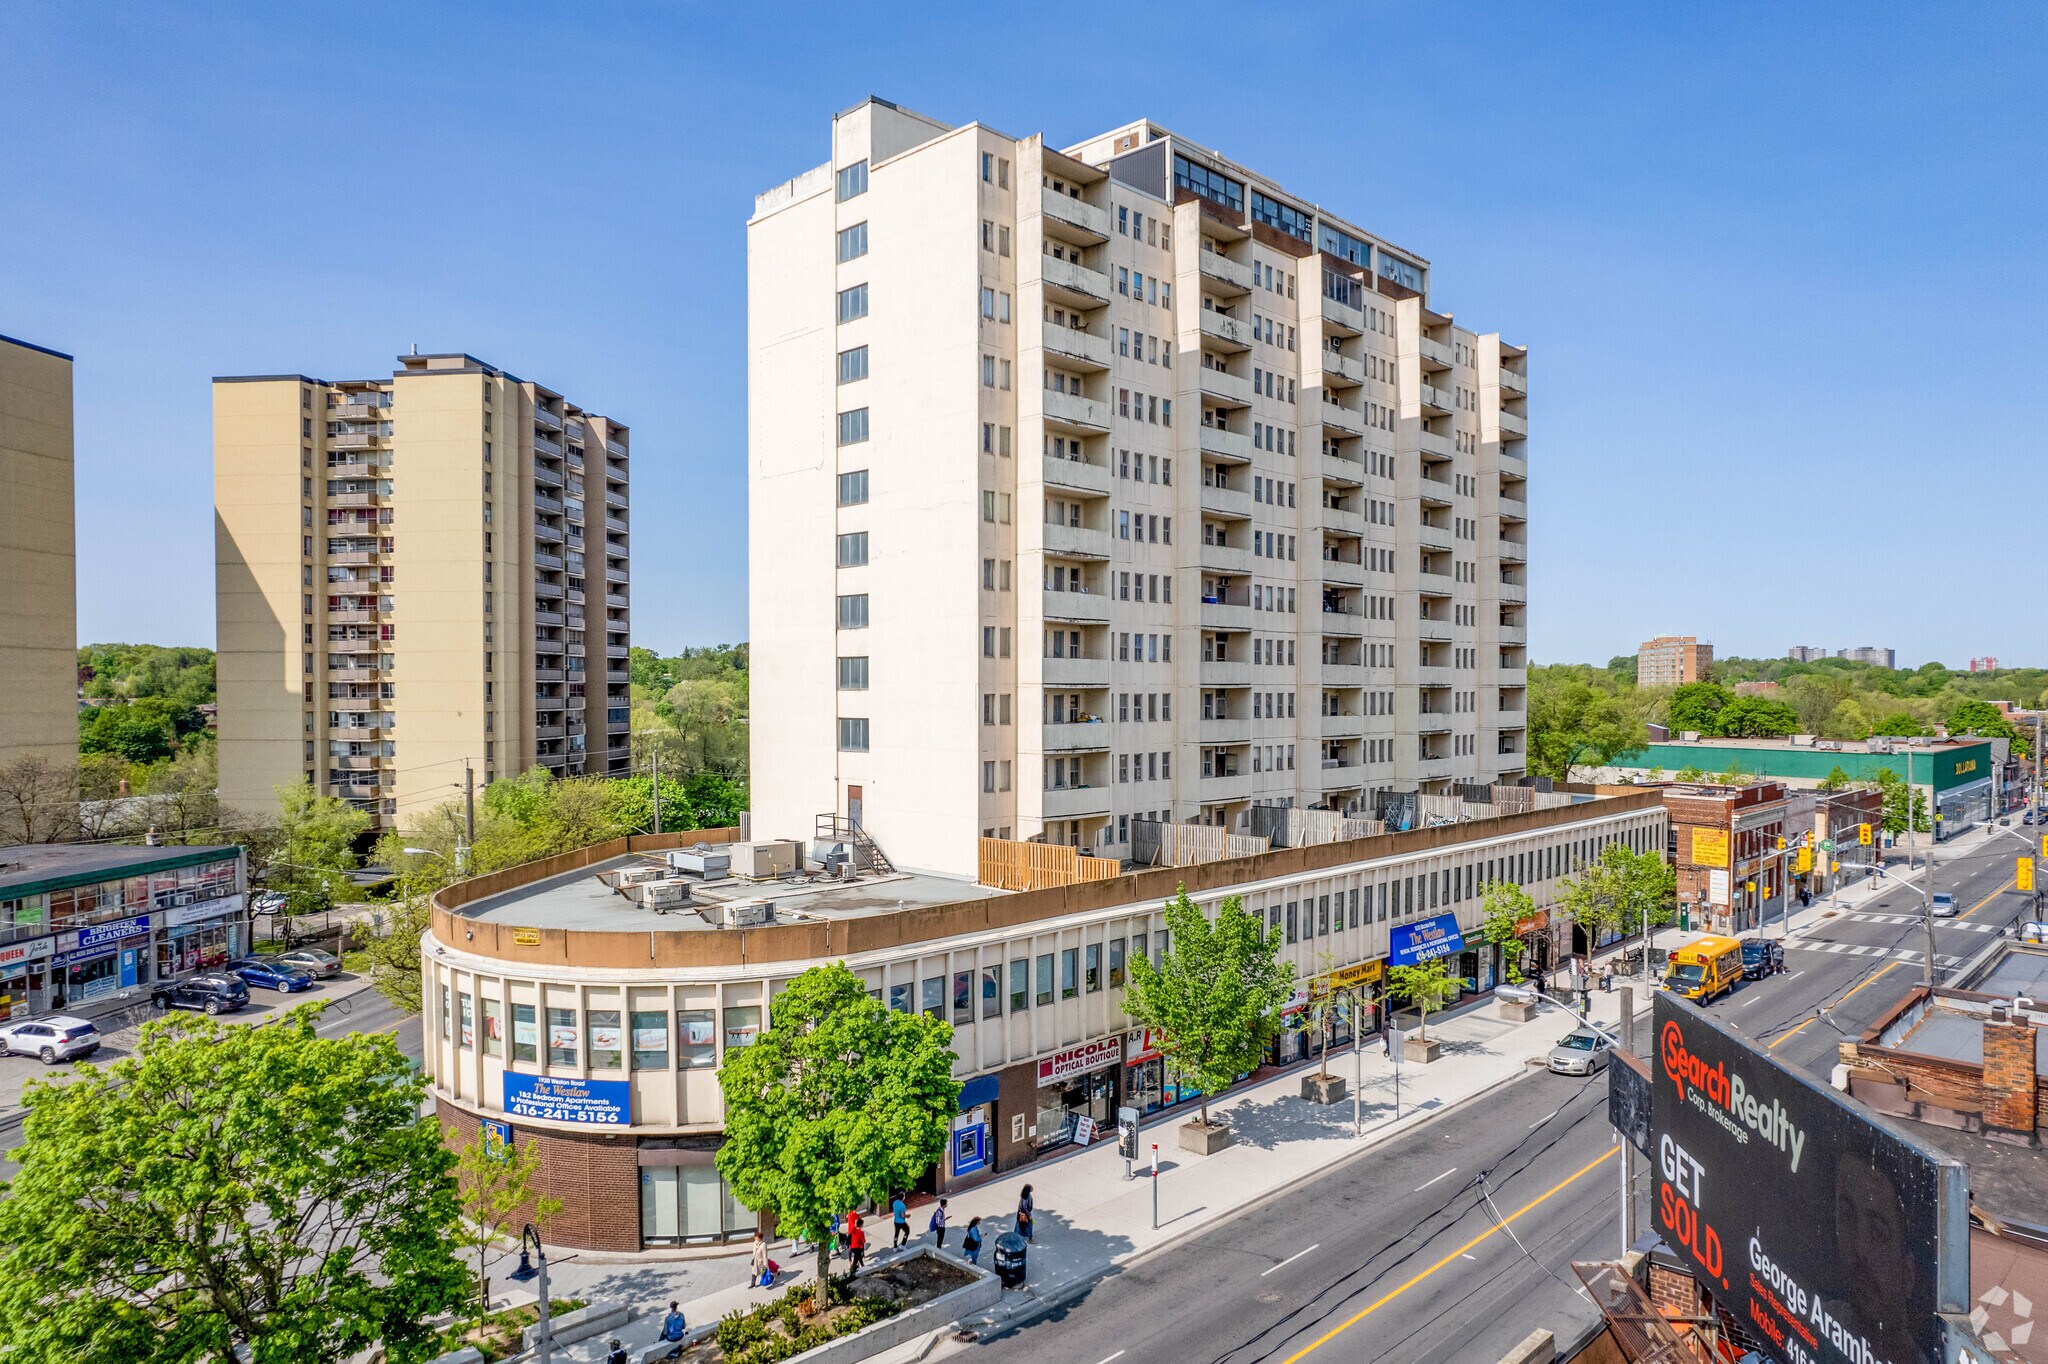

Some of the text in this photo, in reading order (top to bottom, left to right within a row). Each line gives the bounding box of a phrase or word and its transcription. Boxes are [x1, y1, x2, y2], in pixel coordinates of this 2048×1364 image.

[83, 924, 143, 946] CLEANERS
[89, 918, 137, 935] BRIGHTEN
[1409, 932, 1422, 945] The
[0, 948, 24, 962] QUEEN
[1339, 963, 1375, 980] Money Mart
[1054, 1038, 1119, 1065] NICOLA
[1055, 1060, 1083, 1075] OPTICAL
[1086, 1048, 1119, 1065] BOUTIQUE
[533, 1093, 564, 1102] Bedroom
[565, 1097, 609, 1105] Apartments
[534, 1083, 590, 1097] The Westlaw
[513, 1104, 618, 1122] 416-241-5156
[516, 1096, 554, 1108] Professional
[556, 1102, 581, 1110] Offices
[1687, 1086, 1749, 1144] Corp. Brokerage
[1661, 1133, 1705, 1208] GET
[1661, 1182, 1728, 1290] SOLD.
[1750, 1237, 1893, 1364] George Aramb
[1750, 1272, 1819, 1350] Sales Representative
[1750, 1297, 1784, 1351] Mobile:
